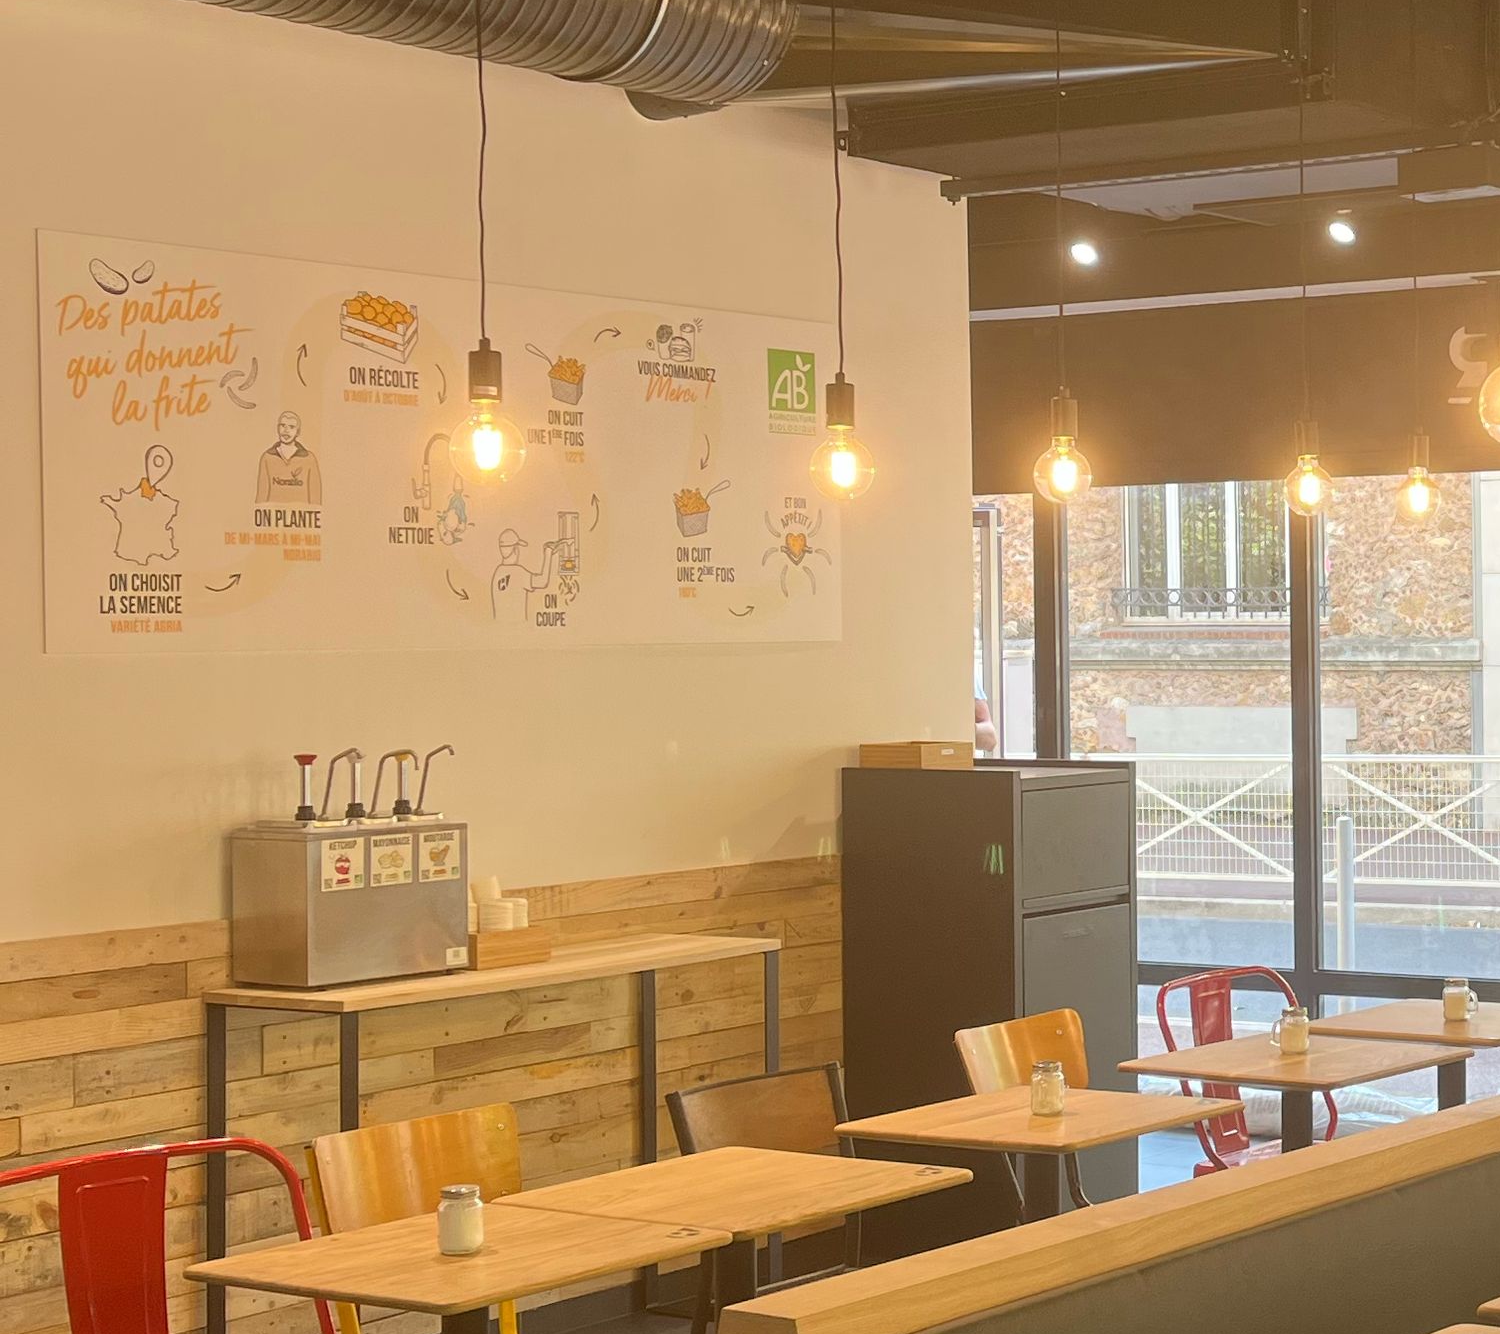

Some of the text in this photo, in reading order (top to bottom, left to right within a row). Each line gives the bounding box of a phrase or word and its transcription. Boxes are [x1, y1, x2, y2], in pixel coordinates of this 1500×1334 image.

[56, 279, 222, 337] Des patates
[66, 323, 255, 399] qui donnent
[349, 365, 419, 390] ON RÉCOLTE
[637, 360, 717, 383] VOUS COMMANDEZ
[645, 376, 697, 403] Merci
[771, 368, 810, 410] AB
[112, 374, 216, 432] la frite
[548, 410, 584, 427] ON CUIT
[527, 428, 547, 445] UNE
[564, 431, 584, 447] FOIS
[784, 497, 792, 509] ET
[254, 509, 322, 529] ON PLANTE
[403, 506, 419, 523] ON
[388, 527, 435, 545] NETTOIE
[676, 547, 712, 563] ON CUIT
[109, 573, 182, 593] ON CHOISIT
[676, 567, 695, 583] UNE
[715, 568, 735, 583] FOIS
[99, 595, 183, 614] LA SEMENCE
[544, 594, 558, 609] ON
[535, 612, 567, 627] COUPE
